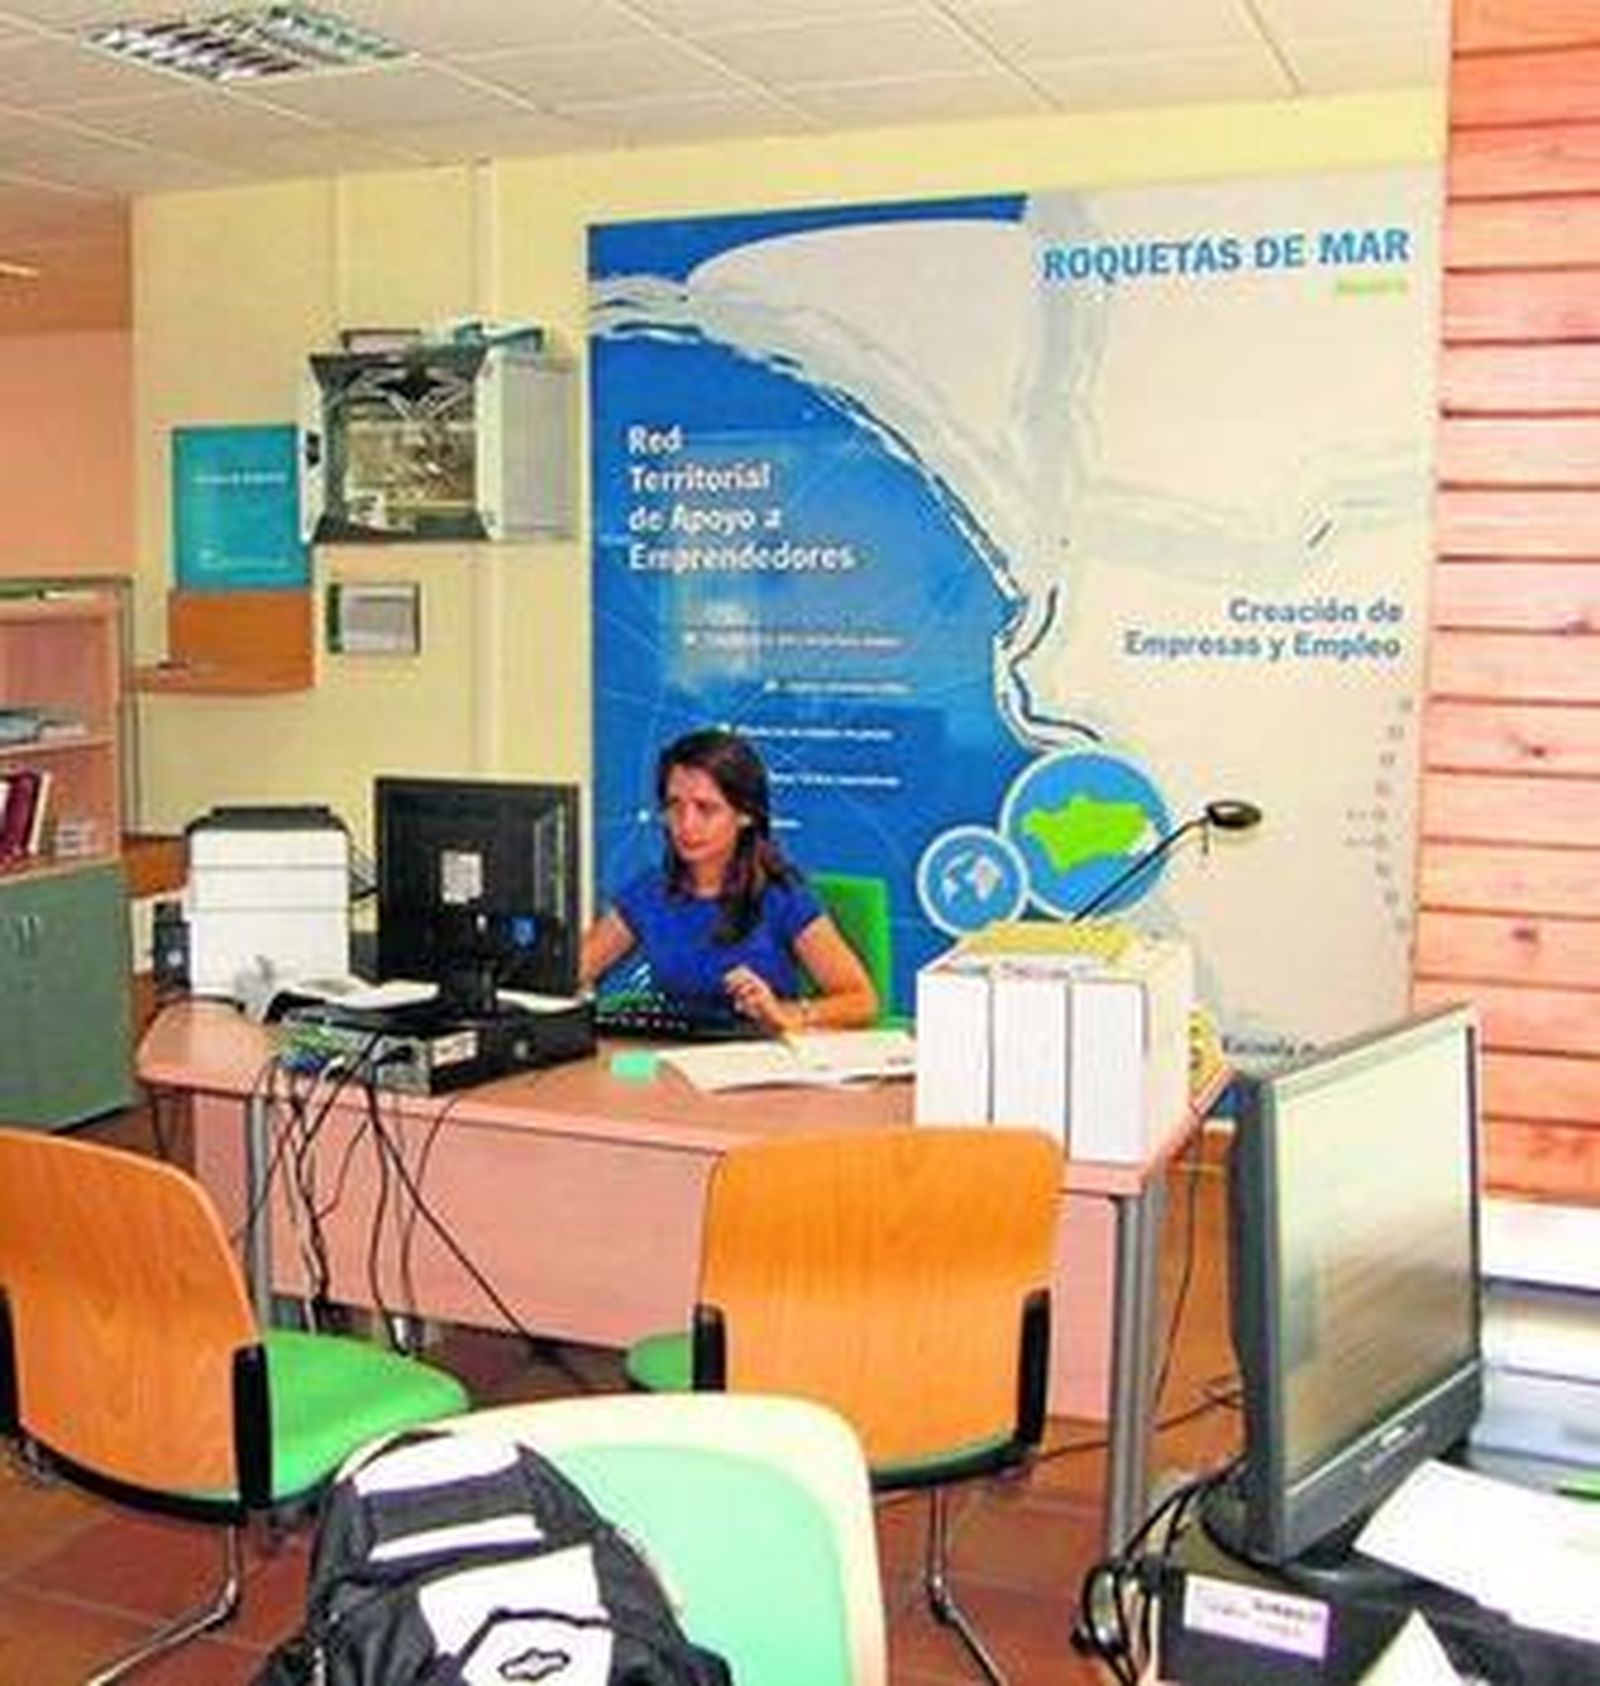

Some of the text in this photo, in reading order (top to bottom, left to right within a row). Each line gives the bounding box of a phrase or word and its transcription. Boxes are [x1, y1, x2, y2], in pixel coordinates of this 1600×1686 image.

[1043, 228, 1410, 283] ROQUETAS DE MAR
[627, 426, 683, 454] Red
[628, 463, 771, 493] Territorial
[628, 504, 781, 536] de Apoyo a
[628, 541, 857, 573] Emprendedores
[1228, 597, 1403, 624] Creación de
[1124, 630, 1401, 661] Empresas y Empleo
